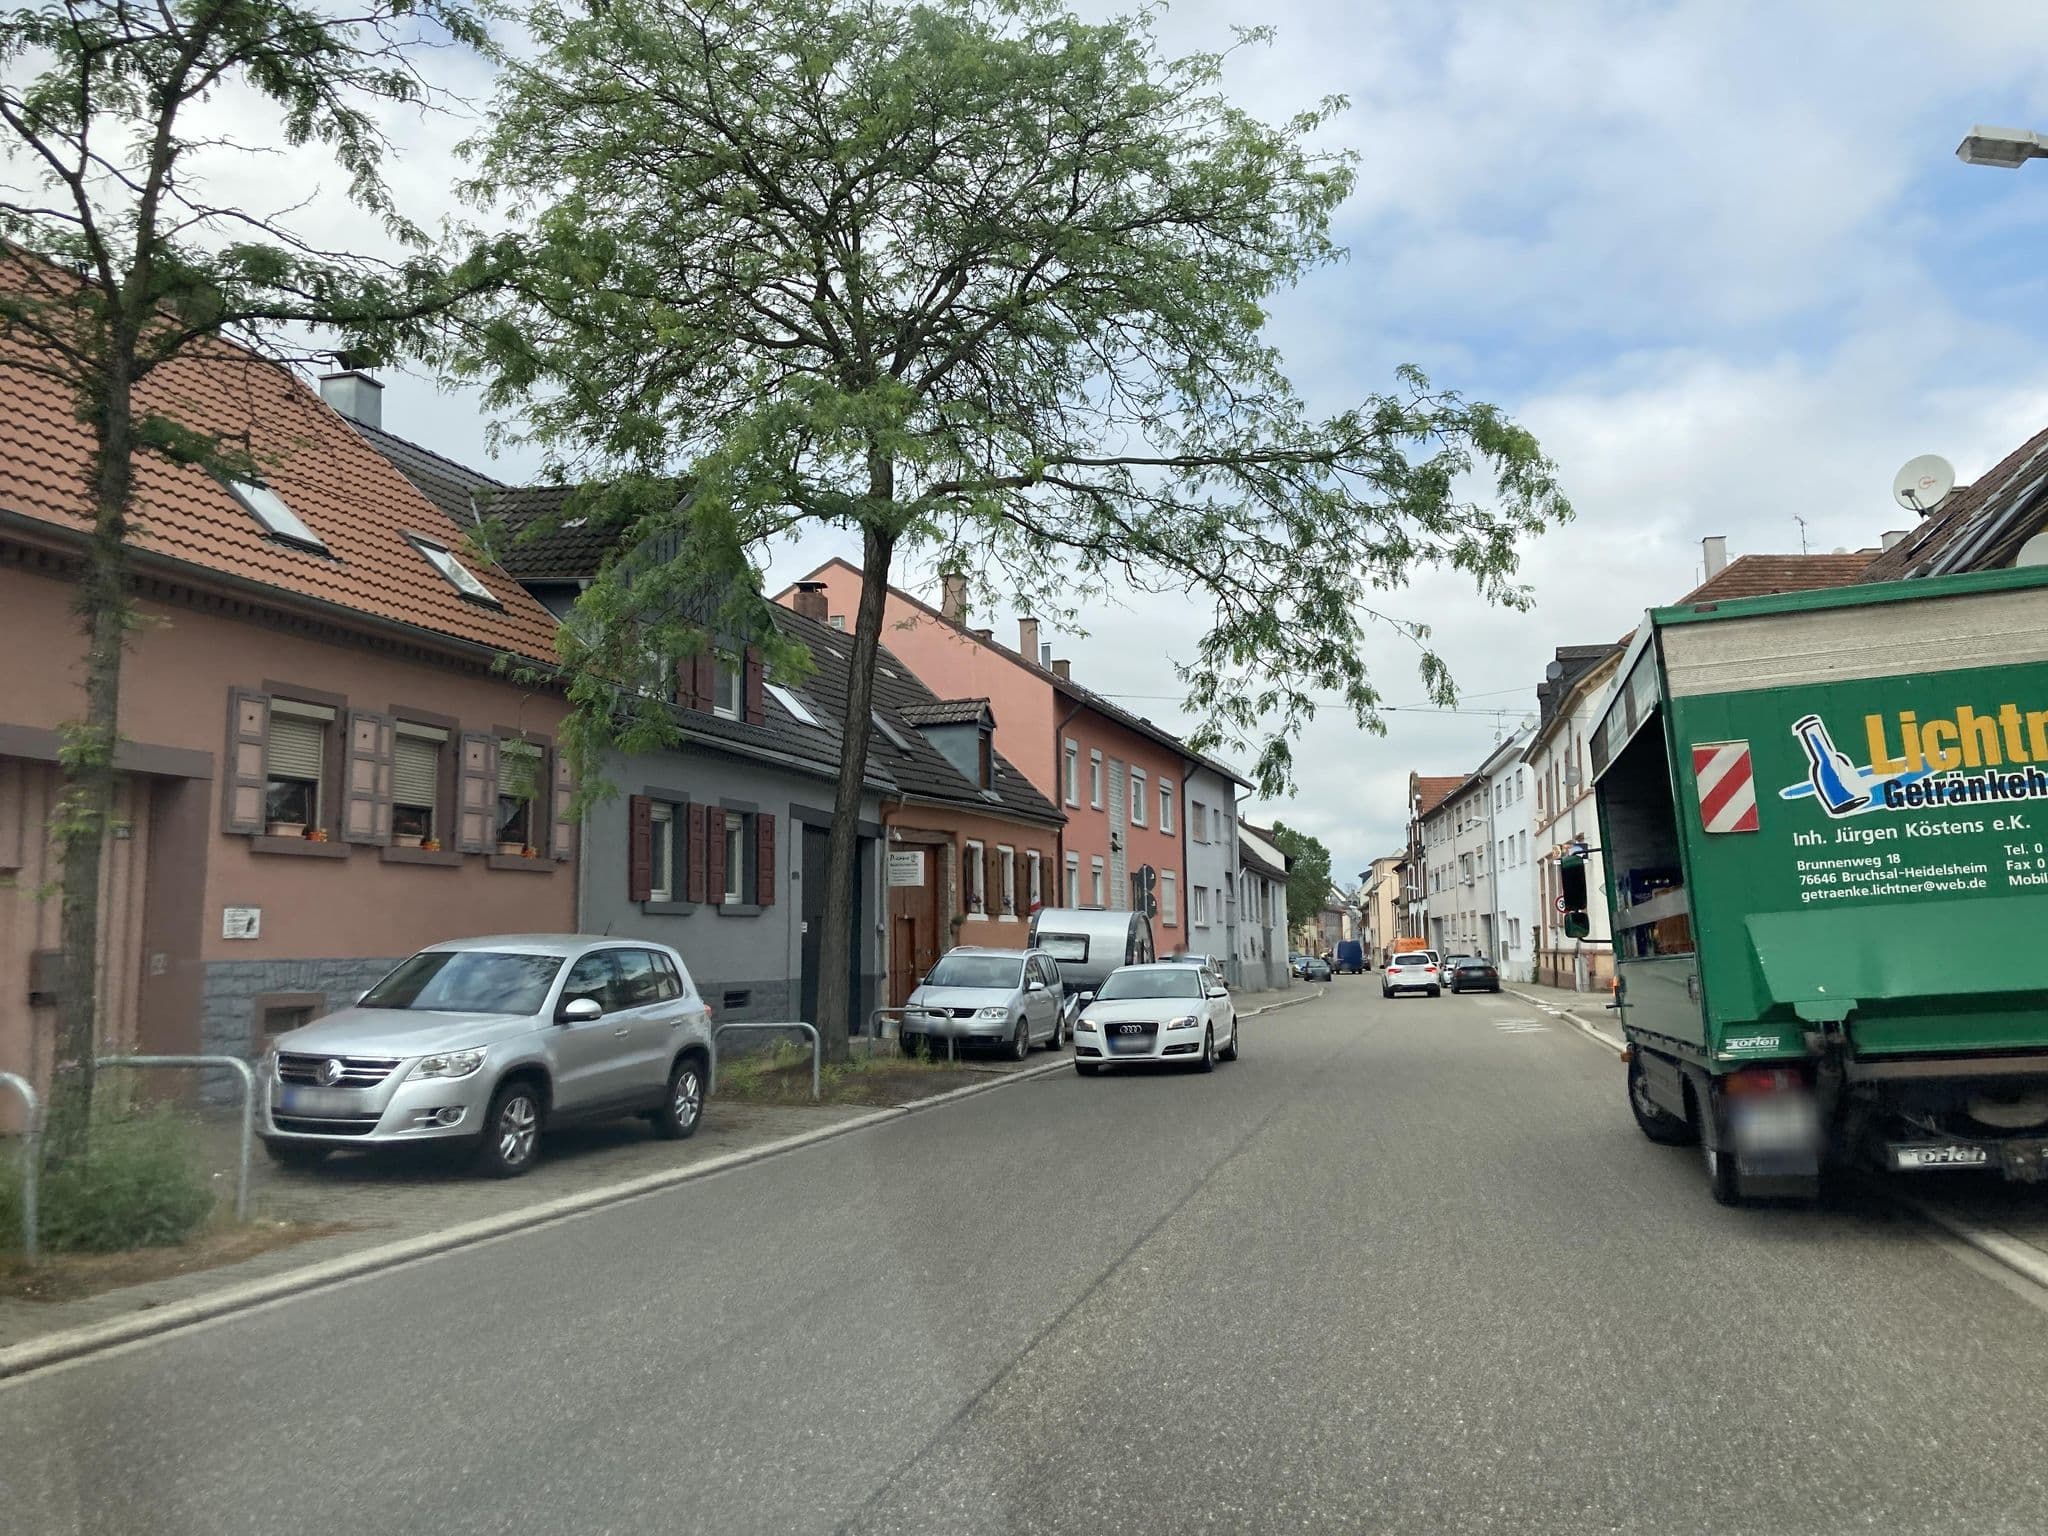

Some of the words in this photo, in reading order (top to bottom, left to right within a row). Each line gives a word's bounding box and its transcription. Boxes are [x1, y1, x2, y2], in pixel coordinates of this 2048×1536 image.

[1793, 829, 1827, 846] Inh.
[1835, 826, 1898, 845] Jürgen
[1905, 820, 1984, 838] Köstens
[1992, 814, 2031, 831] e.K.
[2003, 843, 2029, 856] Tel.
[2034, 843, 2043, 854] 0
[1797, 856, 1881, 871] Brunnenweg
[1886, 853, 1901, 864] 18
[2006, 860, 2031, 871] Fax
[2037, 858, 2046, 869] 0
[1799, 873, 1837, 886] 76646
[1842, 862, 1988, 883] Bruchsal-Heidelsheim
[2008, 872, 2048, 887] Mobil
[1801, 877, 1987, 903] getraenke.lichtner@web.de
